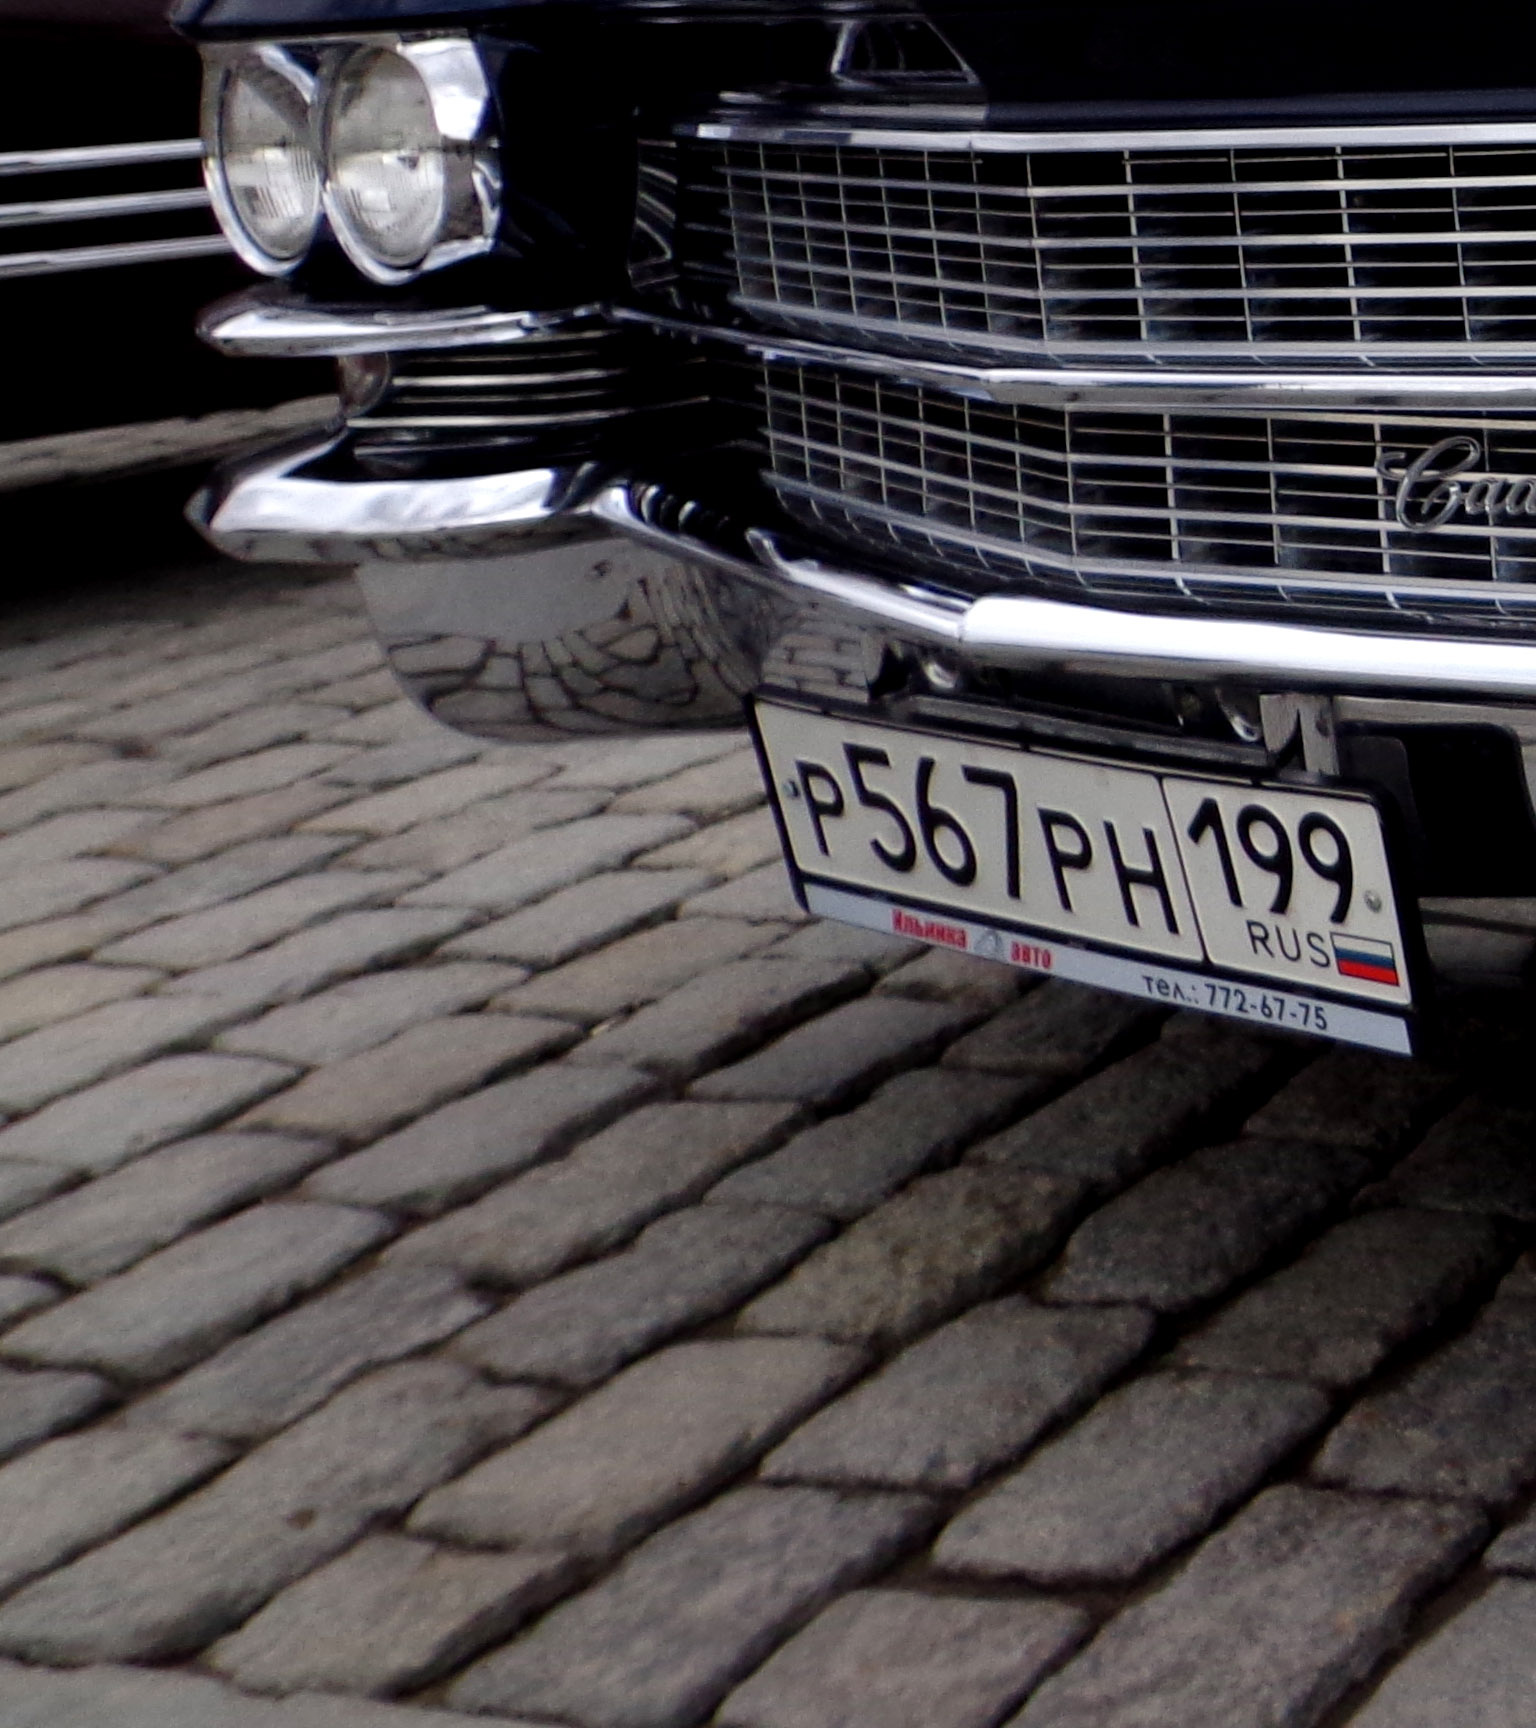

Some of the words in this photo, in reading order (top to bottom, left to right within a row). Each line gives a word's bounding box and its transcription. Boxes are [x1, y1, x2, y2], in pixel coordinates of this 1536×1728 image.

[1187, 796, 1355, 924] 199
[1245, 919, 1332, 969] RUS
[1204, 983, 1328, 1031] 772-67-75
